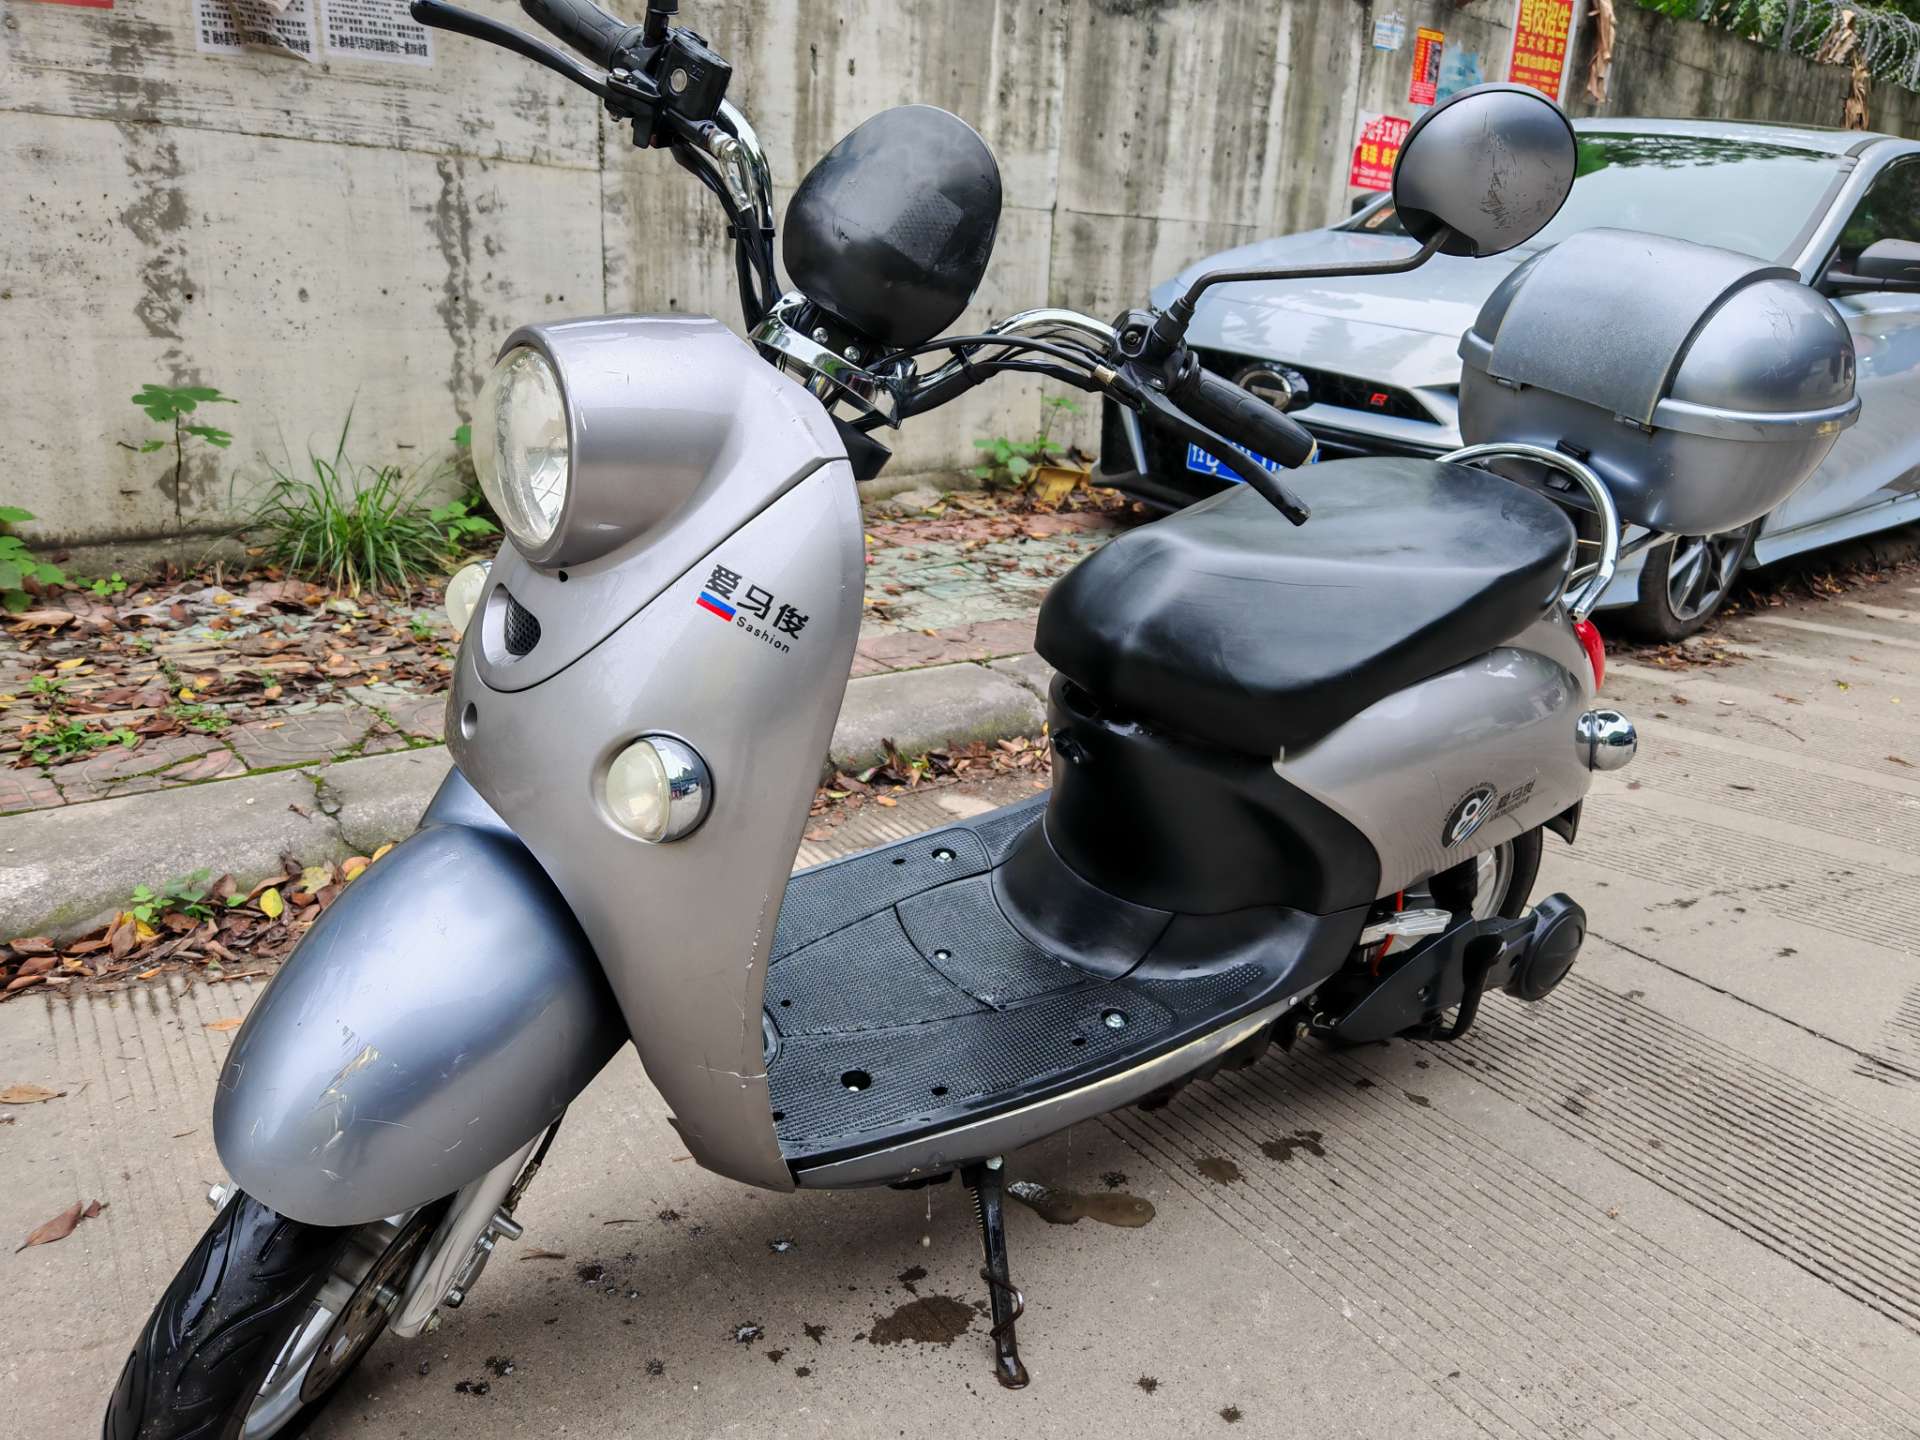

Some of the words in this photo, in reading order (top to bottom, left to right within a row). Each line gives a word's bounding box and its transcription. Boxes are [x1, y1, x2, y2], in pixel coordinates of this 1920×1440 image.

[1519, 0, 1570, 39] 驾校招生
[736, 616, 790, 654] Sashion
